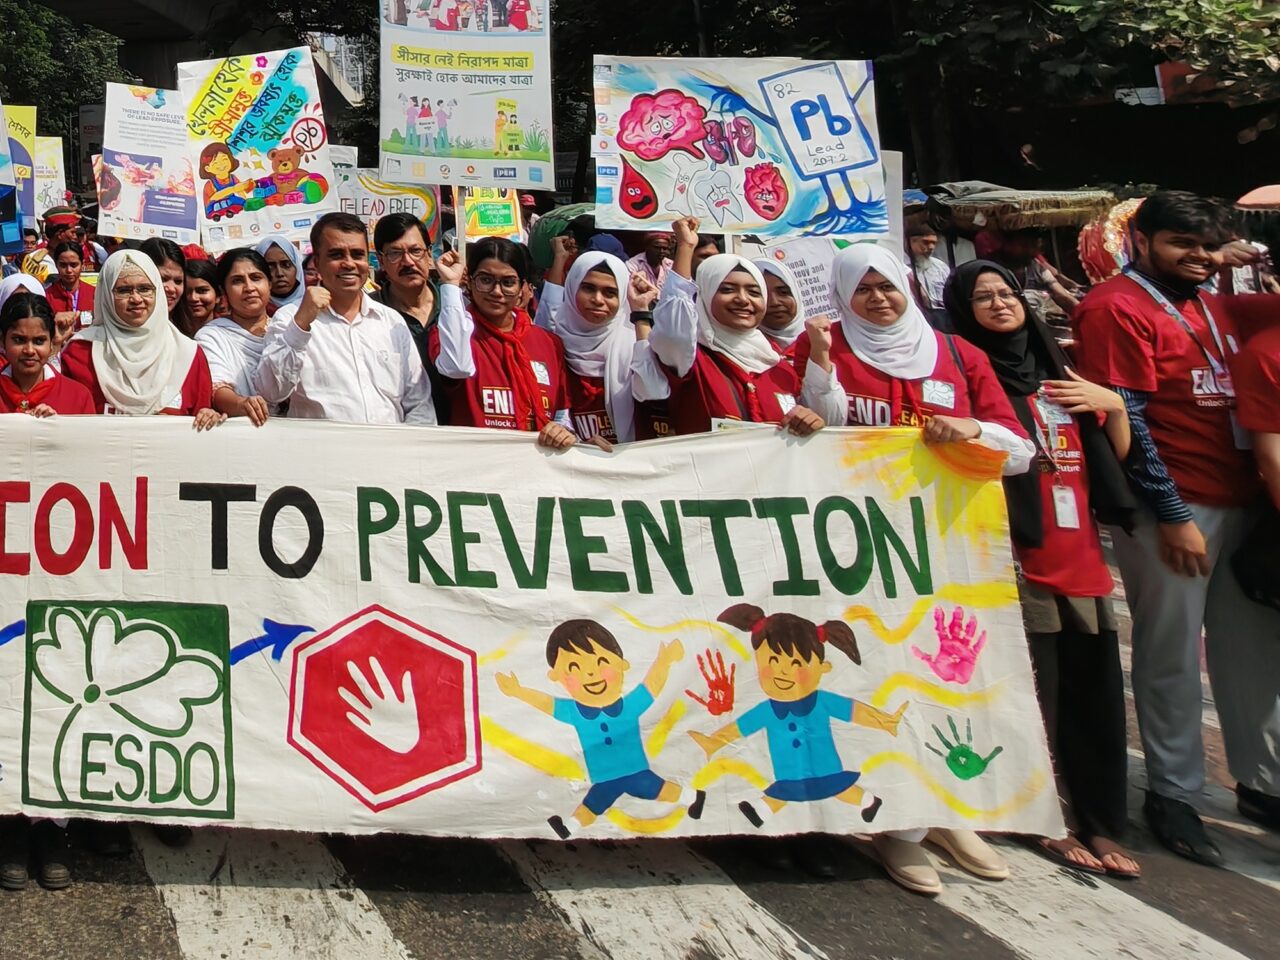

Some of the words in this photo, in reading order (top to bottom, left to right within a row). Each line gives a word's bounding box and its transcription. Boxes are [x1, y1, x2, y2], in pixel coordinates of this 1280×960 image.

[773, 82, 801, 99] 82
[790, 94, 852, 141] Pb
[808, 139, 845, 157] Lead
[794, 268, 810, 278] tegy
[485, 419, 511, 427] Unlock
[574, 414, 599, 440] ND
[599, 416, 611, 429] LE
[653, 421, 669, 434] AD
[179, 482, 324, 579] TO
[357, 486, 934, 599] PREVENTION
[80, 733, 220, 806] ESDO
